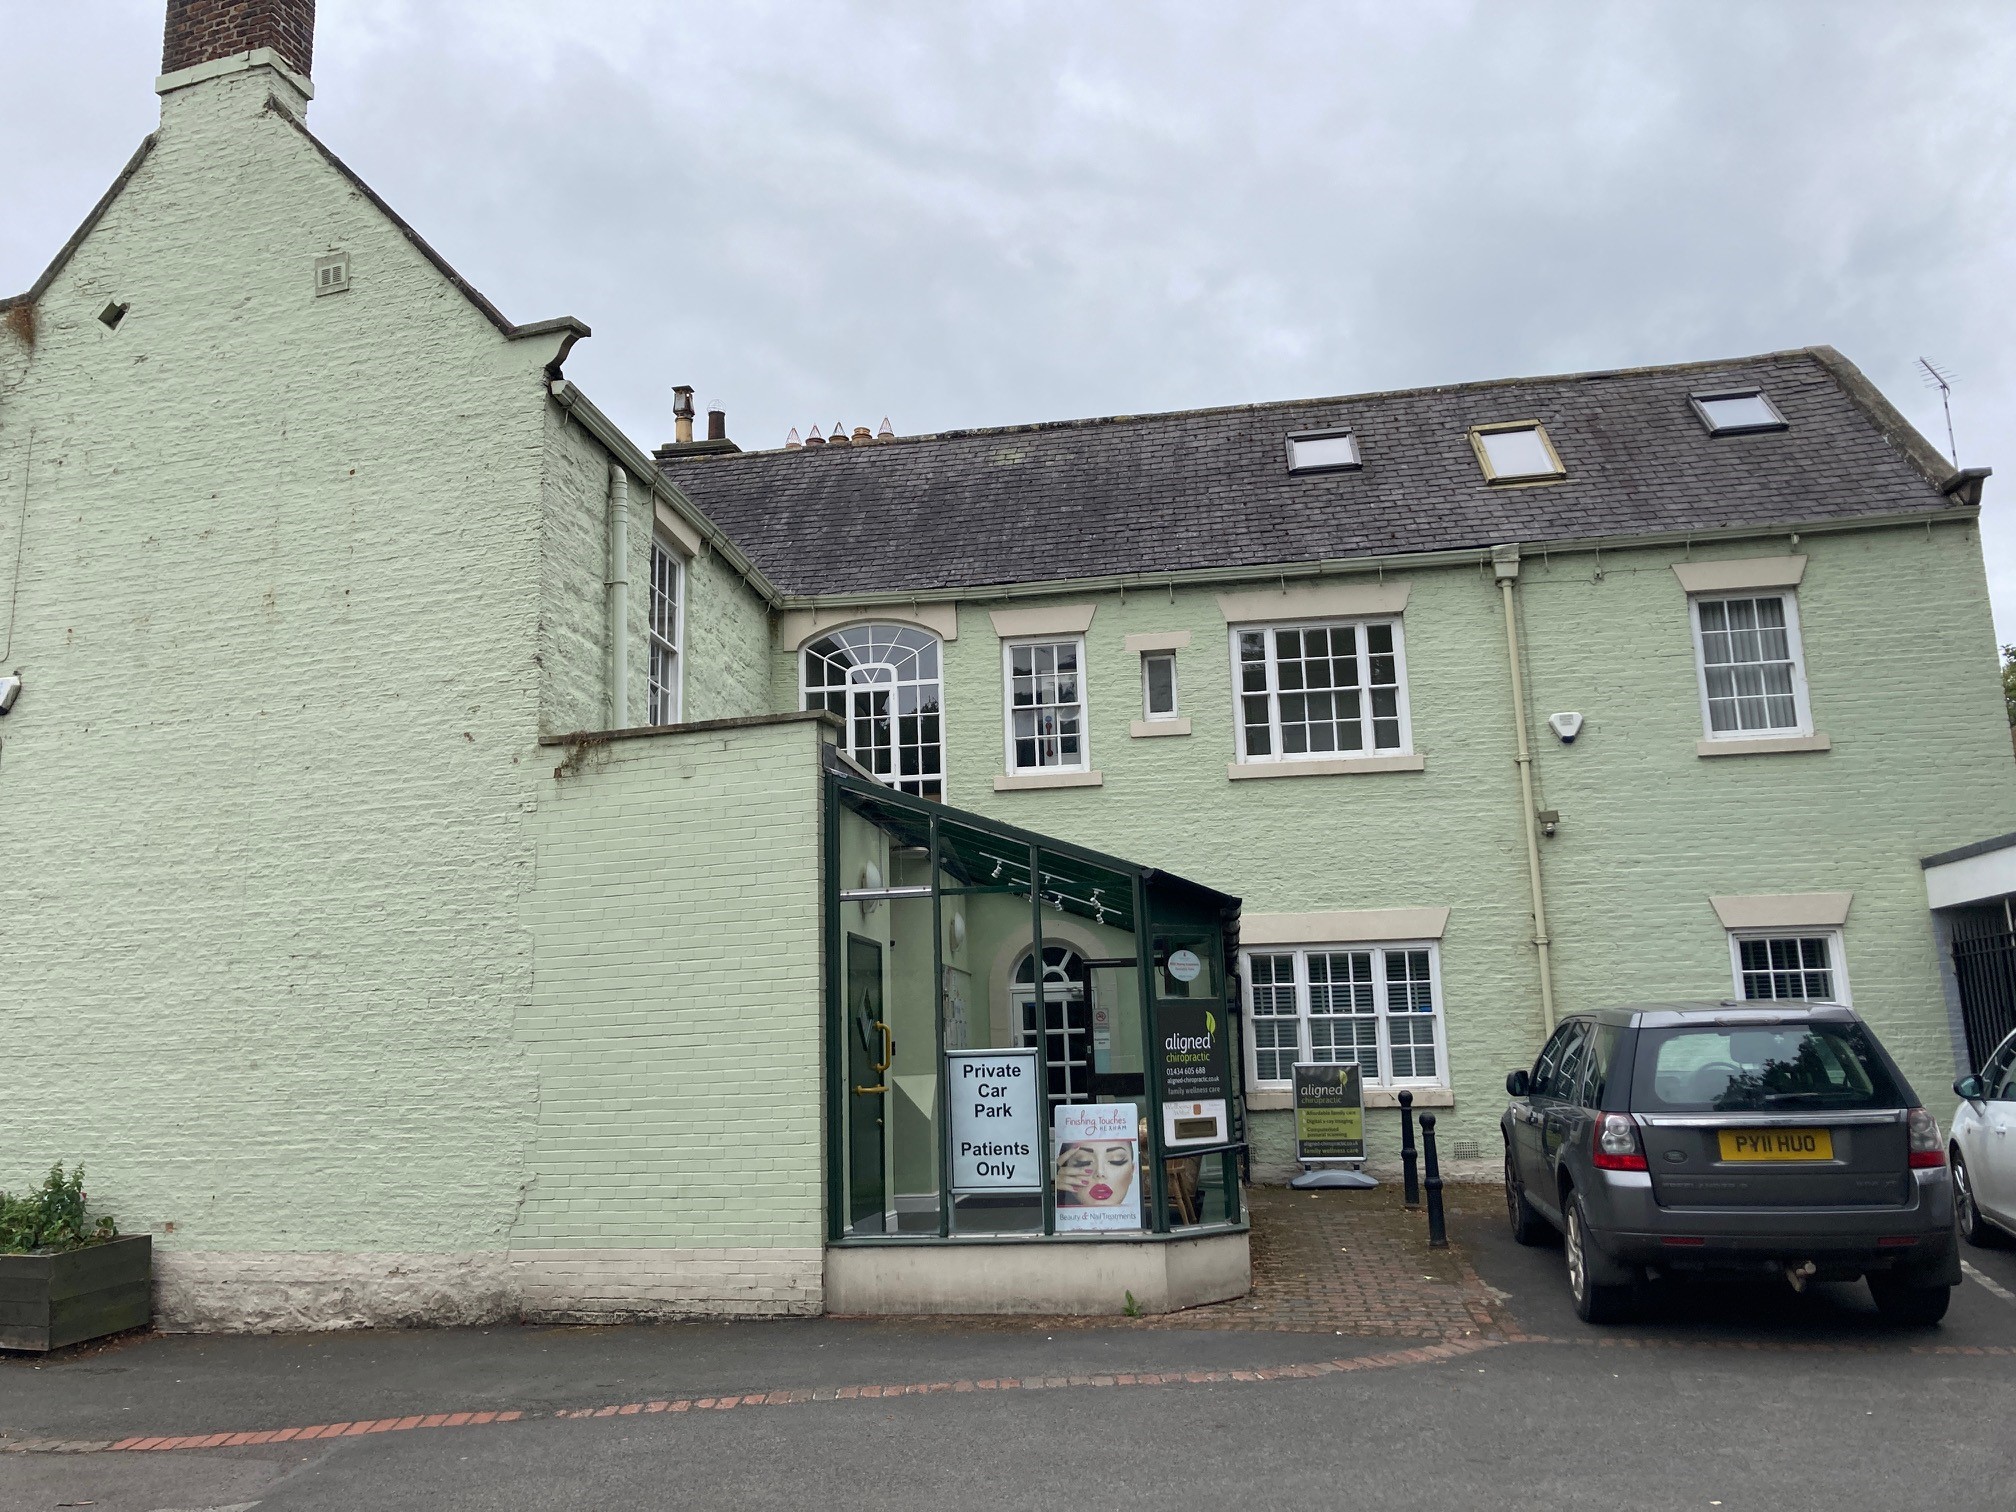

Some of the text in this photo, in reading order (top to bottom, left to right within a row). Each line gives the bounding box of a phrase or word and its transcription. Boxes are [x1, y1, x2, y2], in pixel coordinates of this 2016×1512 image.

[1165, 1032, 1211, 1054] aligned
[1166, 1052, 1210, 1064] chiropractic
[963, 1064, 1021, 1078] Private
[1166, 1067, 1184, 1075] 01434
[1184, 1067, 1195, 1075] 605
[978, 1083, 1007, 1097] Car
[1168, 1087, 1185, 1095] family
[1185, 1086, 1208, 1094] wellness
[1301, 1084, 1343, 1098] aligned
[1301, 1097, 1342, 1105] chiropractic
[974, 1103, 1012, 1117] Park
[1065, 1109, 1127, 1135] Finishing Touches
[961, 1142, 1030, 1156] Patients
[1736, 1135, 1815, 1152] PY11 HUO
[976, 1161, 1015, 1179] Only
[1060, 1213, 1080, 1221] Beauty
[1081, 1212, 1088, 1220] &
[1102, 1212, 1137, 1220] Treatments
